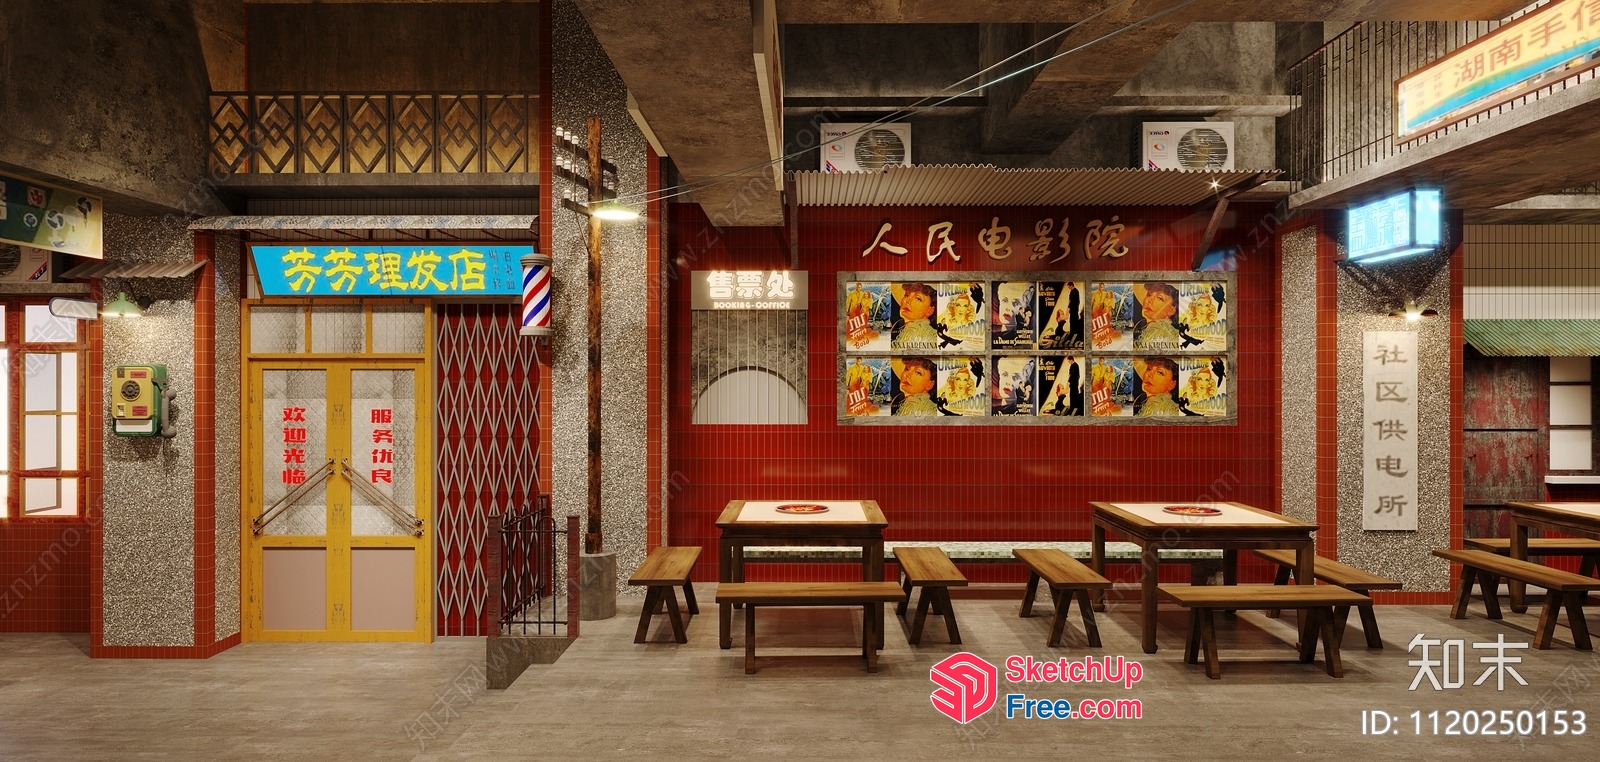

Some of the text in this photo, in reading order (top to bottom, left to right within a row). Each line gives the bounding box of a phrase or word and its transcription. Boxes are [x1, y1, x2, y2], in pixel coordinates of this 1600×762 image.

[862, 215, 1129, 264] 人民电影院
[281, 247, 487, 293] 芳芳理发店
[706, 270, 795, 300] 售票处
[849, 313, 866, 331] SOS
[1092, 313, 1108, 331] SOS
[849, 387, 866, 405] SOS
[1092, 387, 1108, 405] SOS
[282, 406, 306, 485] 欢迎光临
[371, 408, 394, 484] 服务优良
[1372, 345, 1408, 517] 社区供电所
